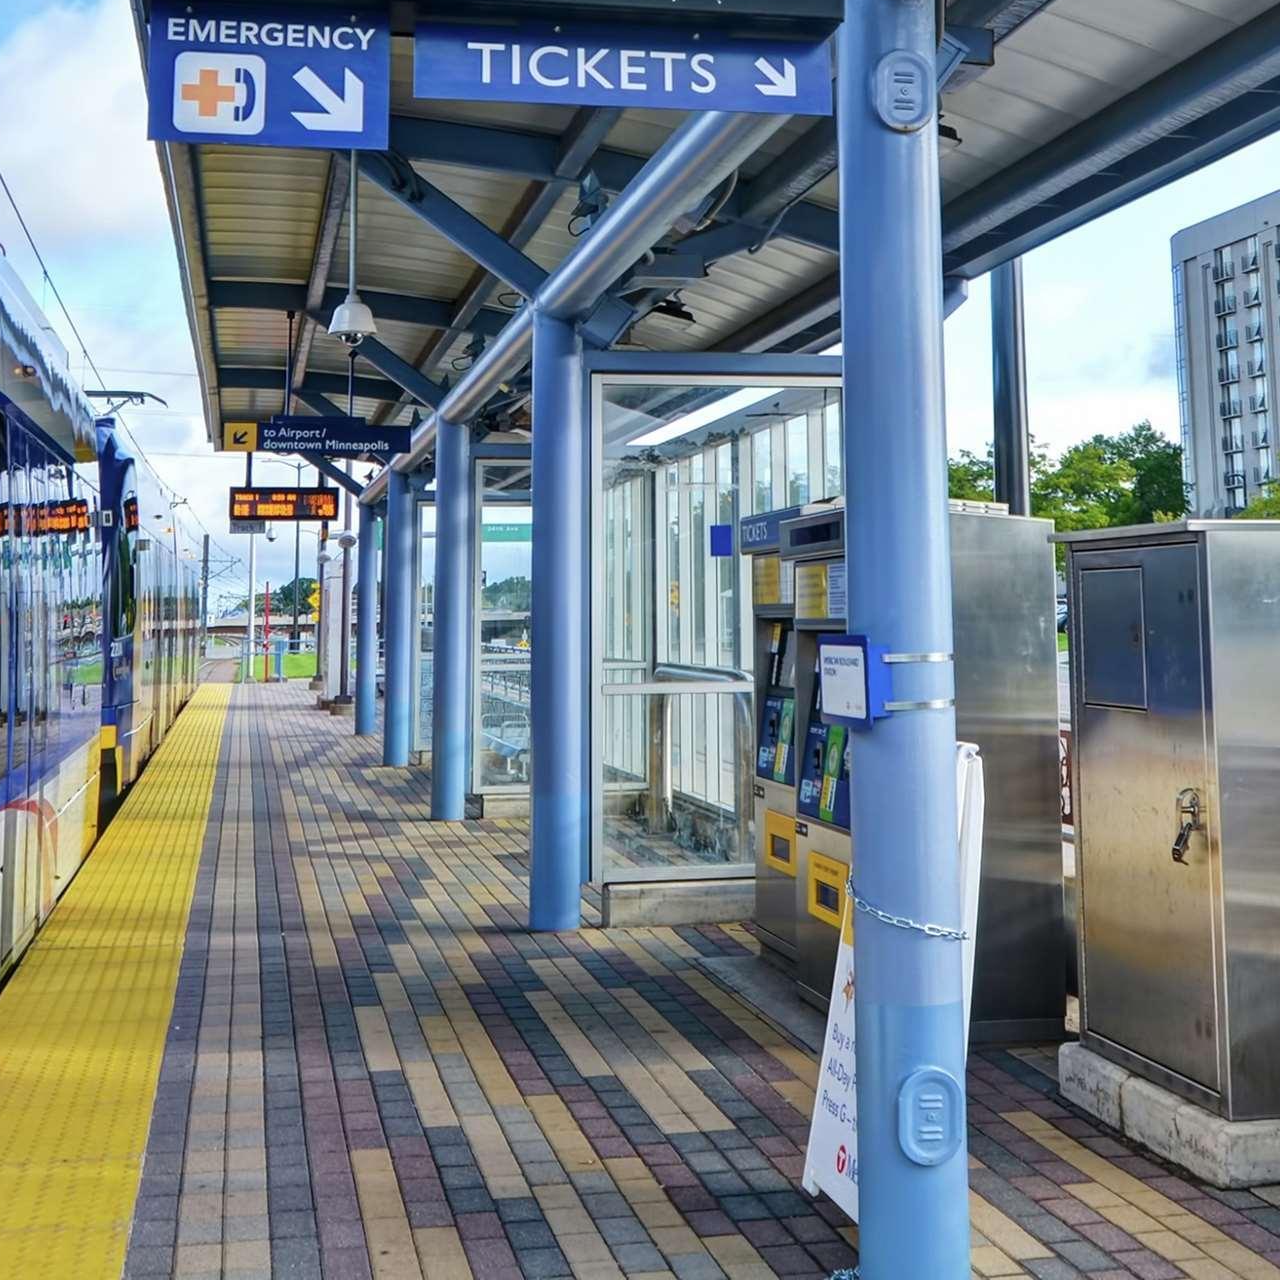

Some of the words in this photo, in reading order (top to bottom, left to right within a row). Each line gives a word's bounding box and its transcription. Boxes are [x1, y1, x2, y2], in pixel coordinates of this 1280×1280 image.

[167, 17, 376, 50] EMERGENCY
[467, 41, 716, 94] TICKETS
[263, 429, 276, 438] to
[263, 440, 322, 450] downtown
[325, 440, 390, 452] Minneapolis
[741, 521, 768, 542] TICKETS
[831, 1023, 845, 1051] Buy
[821, 1089, 839, 1118] Press
